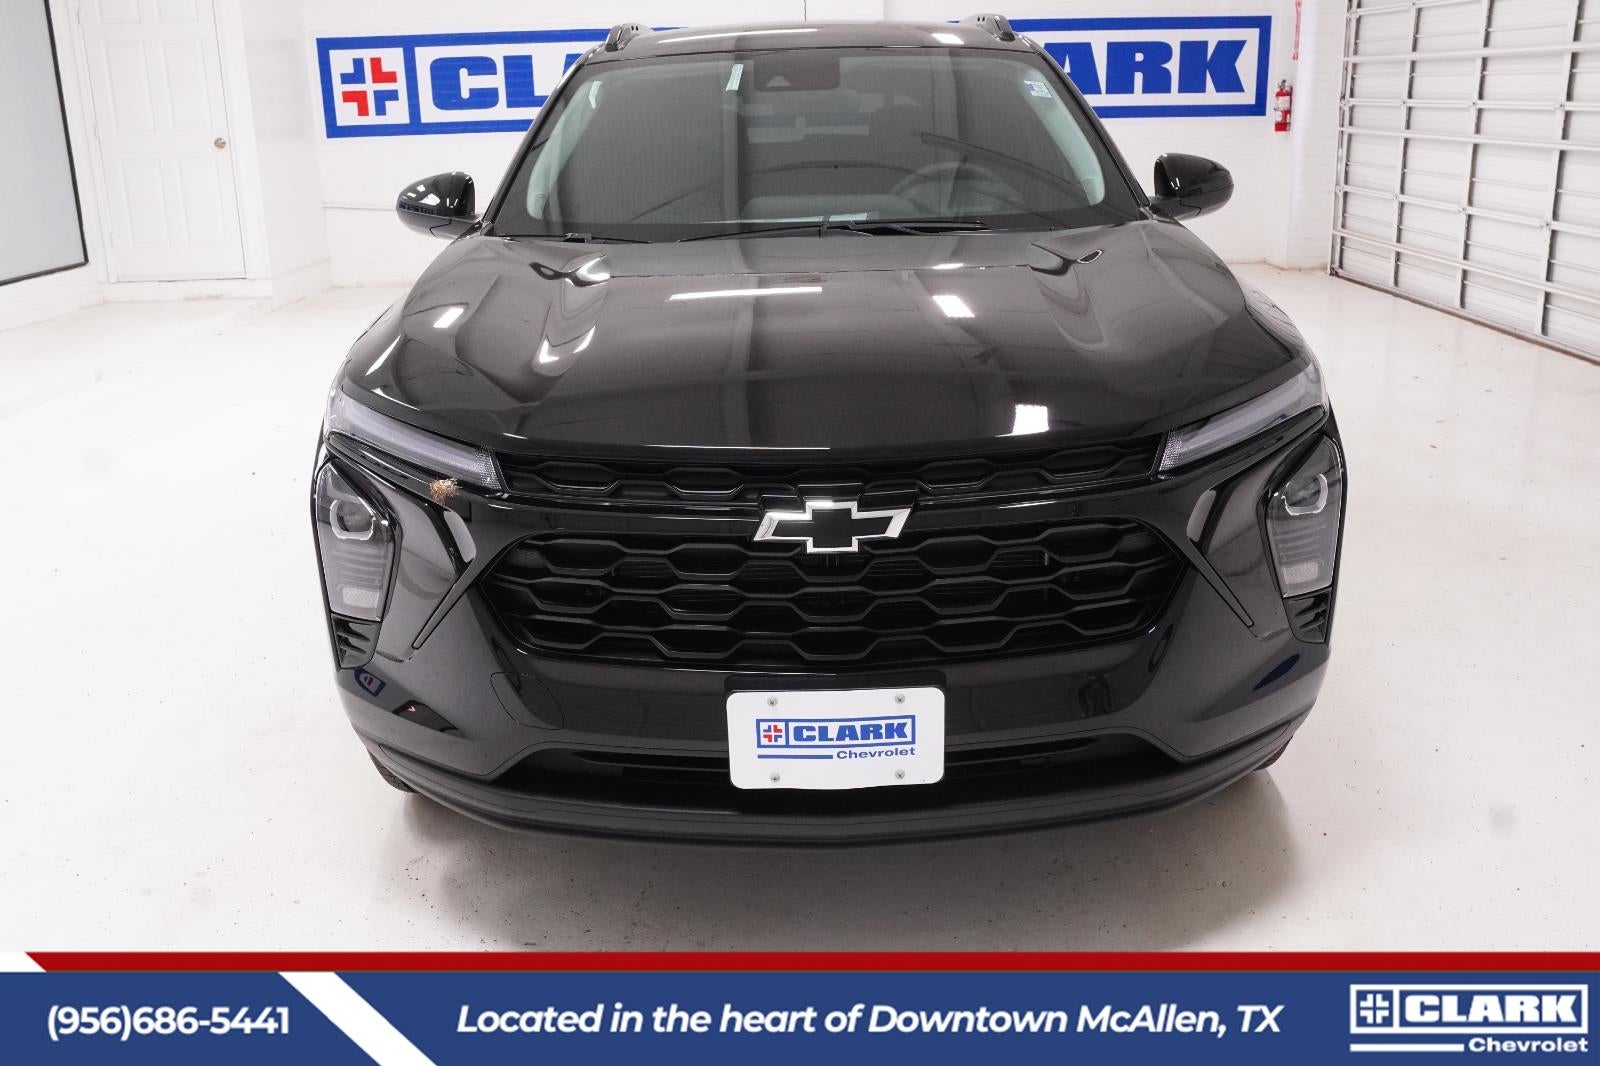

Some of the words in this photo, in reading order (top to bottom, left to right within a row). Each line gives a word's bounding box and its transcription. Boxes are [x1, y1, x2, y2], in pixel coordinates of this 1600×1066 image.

[429, 53, 583, 111] CL
[793, 722, 908, 743] CLARK
[836, 747, 916, 760] Chevrolet
